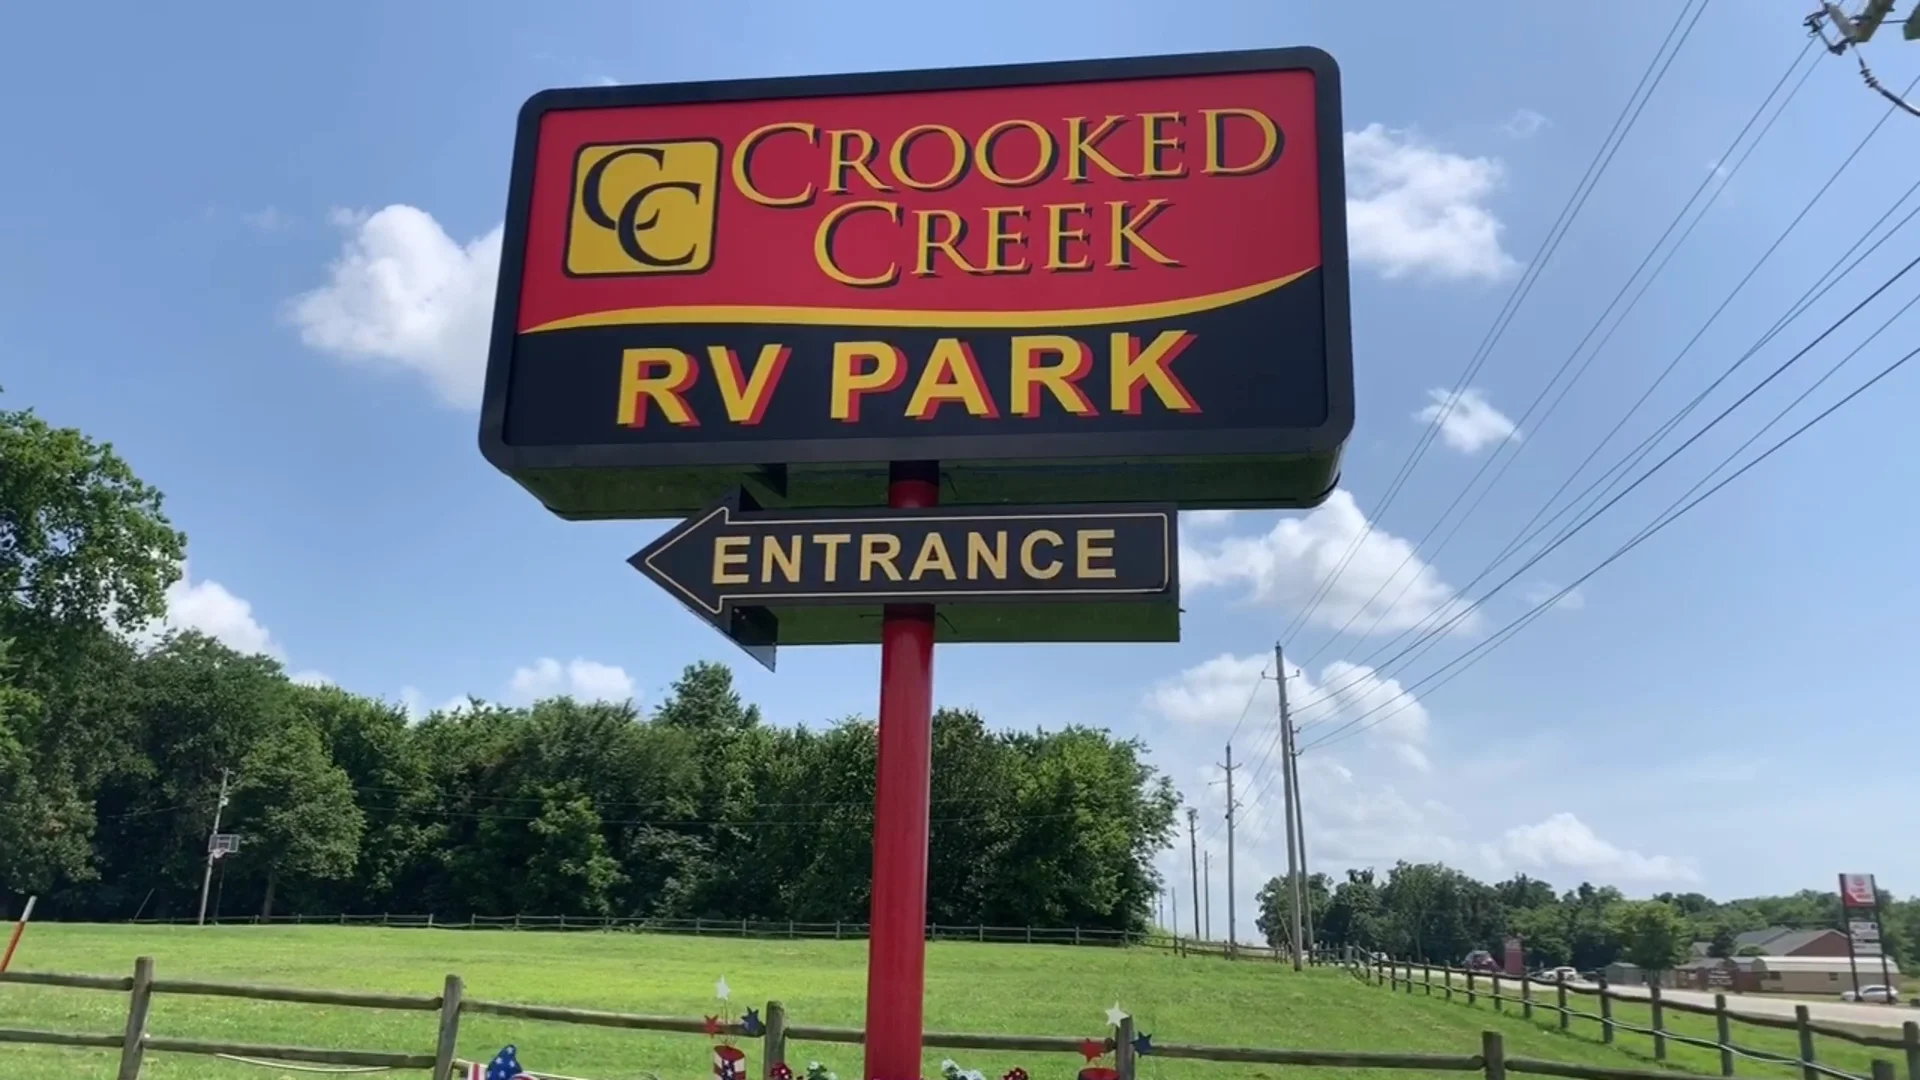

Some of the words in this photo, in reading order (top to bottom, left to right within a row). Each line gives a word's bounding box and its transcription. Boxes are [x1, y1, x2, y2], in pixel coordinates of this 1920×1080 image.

[732, 107, 1283, 208] CROOKED
[813, 198, 1180, 286] CREEK
[616, 344, 788, 426] RV
[831, 330, 1201, 420] PARK
[711, 529, 1117, 585] ENTRANCE
